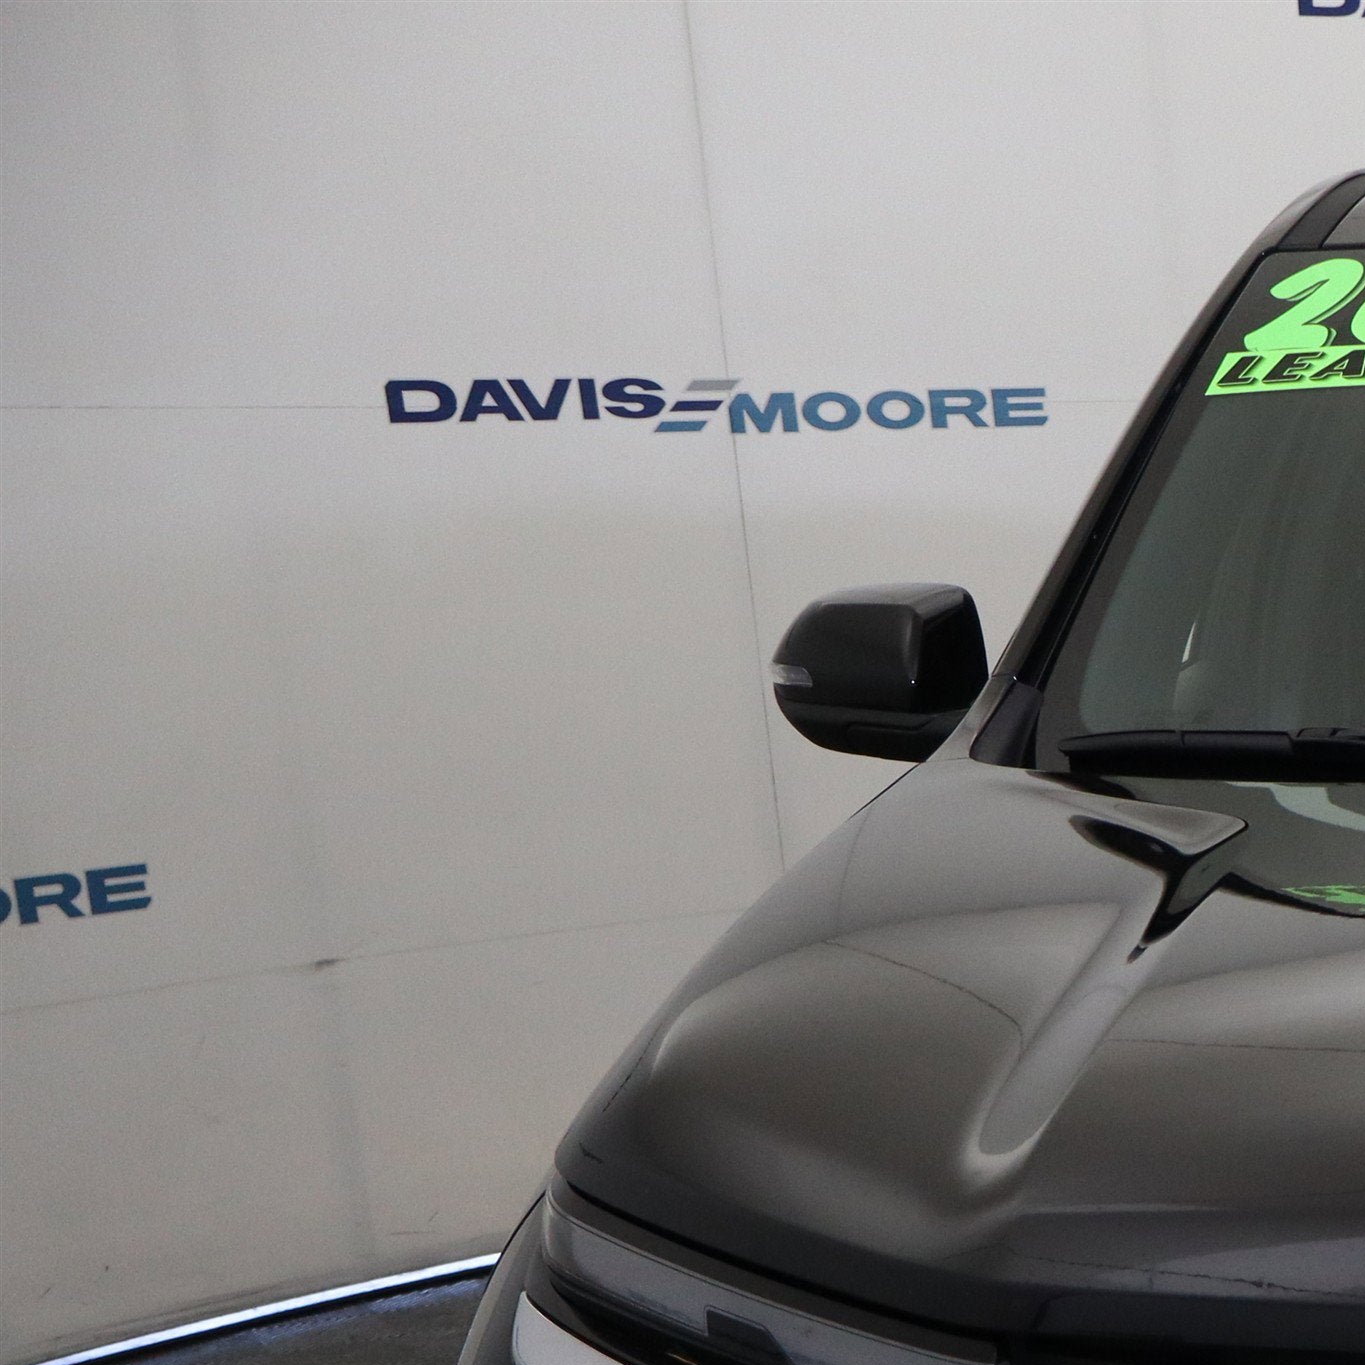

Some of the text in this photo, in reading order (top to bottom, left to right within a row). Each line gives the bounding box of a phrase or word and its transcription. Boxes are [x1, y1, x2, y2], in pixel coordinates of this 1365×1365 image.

[386, 377, 1050, 434] DAVIS MOORE
[0, 863, 152, 925] RE
